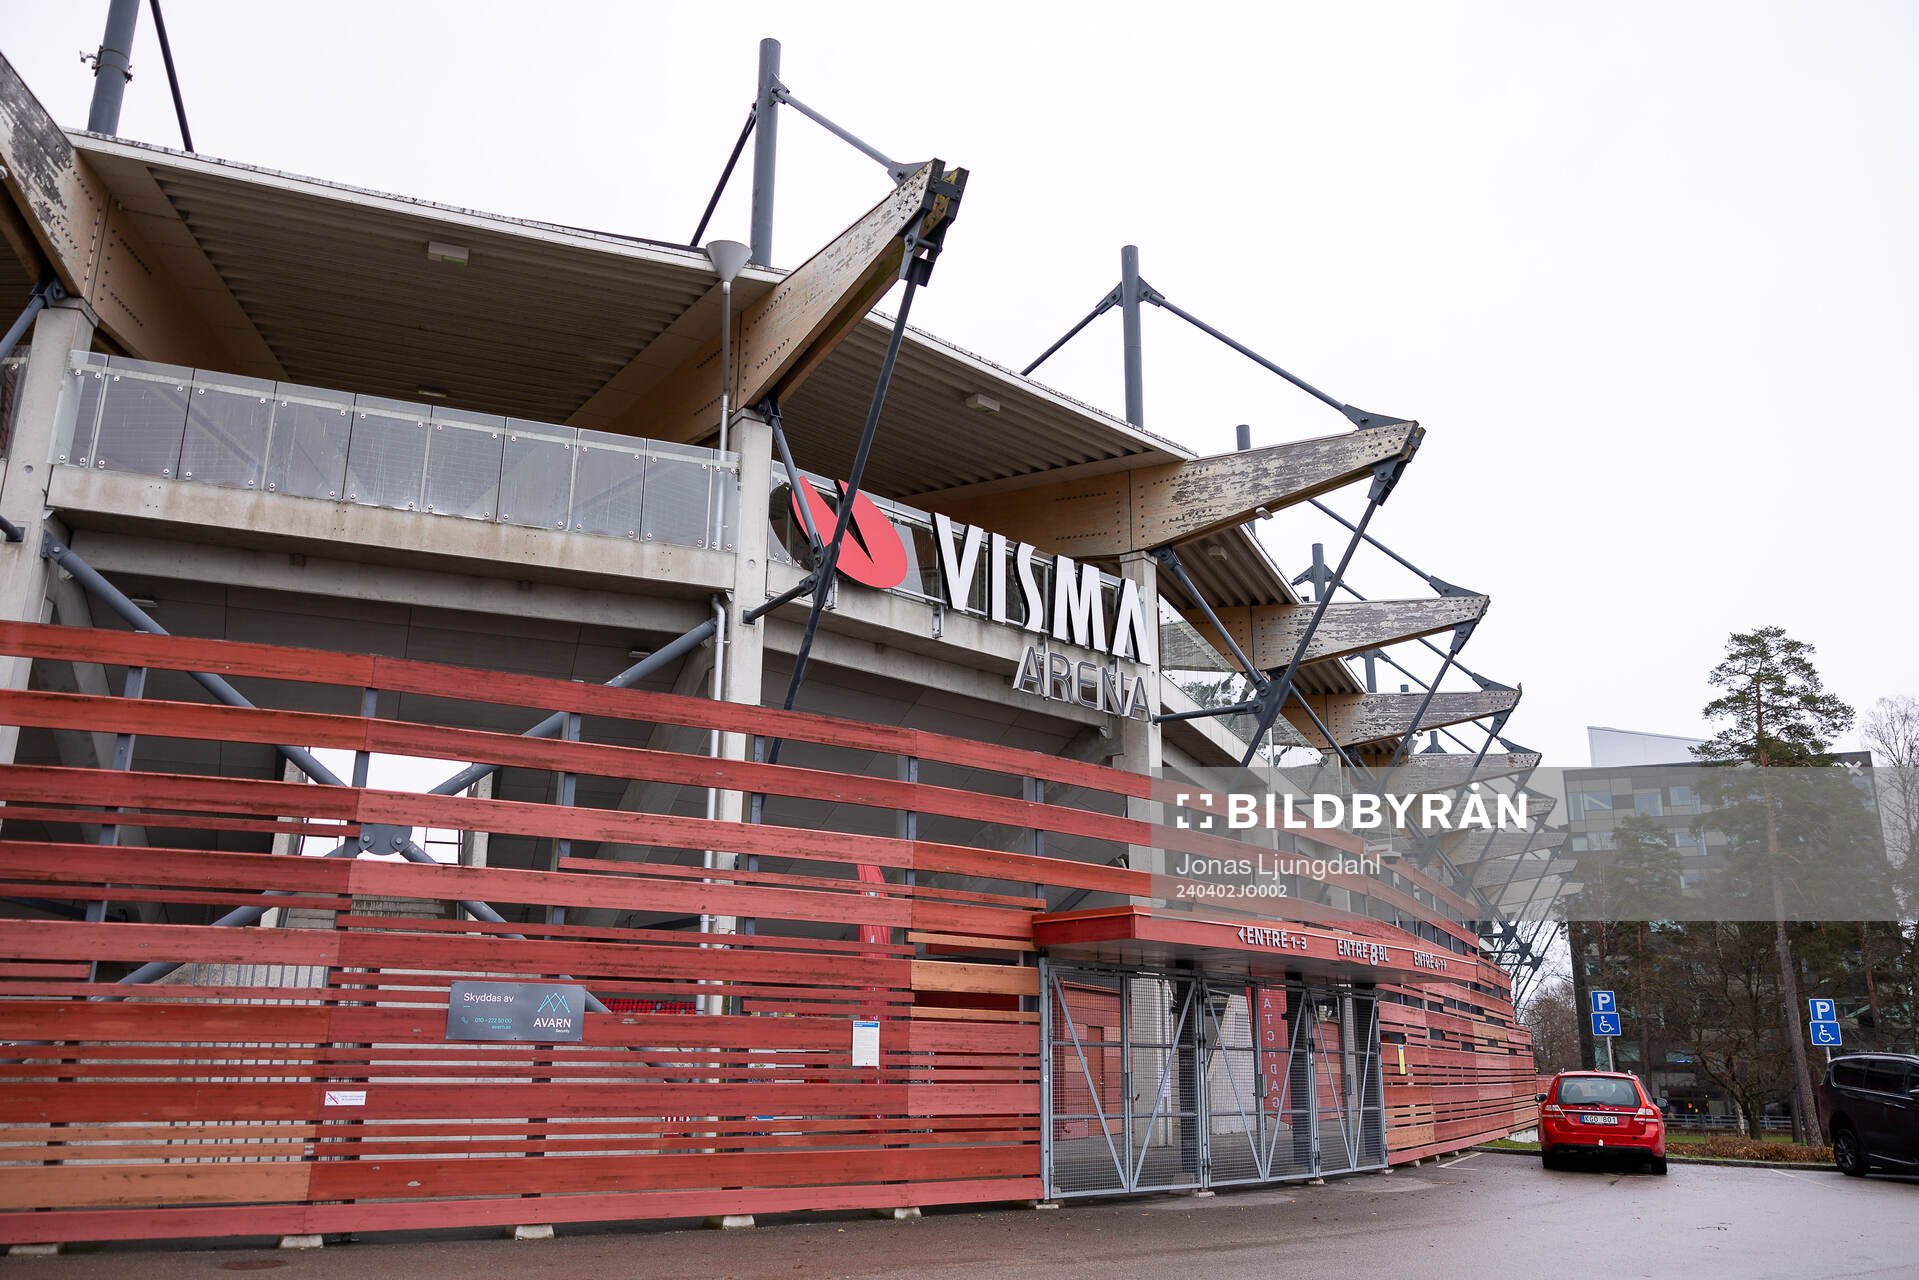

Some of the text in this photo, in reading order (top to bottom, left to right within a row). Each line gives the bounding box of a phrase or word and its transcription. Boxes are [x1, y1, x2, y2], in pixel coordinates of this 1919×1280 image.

[931, 512, 1152, 665] VISMA
[1012, 645, 1153, 722] ARENA
[1246, 927, 1307, 950] ENTRÉ 1-3
[463, 992, 502, 1003] Skyddas
[1598, 993, 1611, 1010] P
[1816, 1001, 1830, 1019] P
[533, 1018, 571, 1028] AVARN
